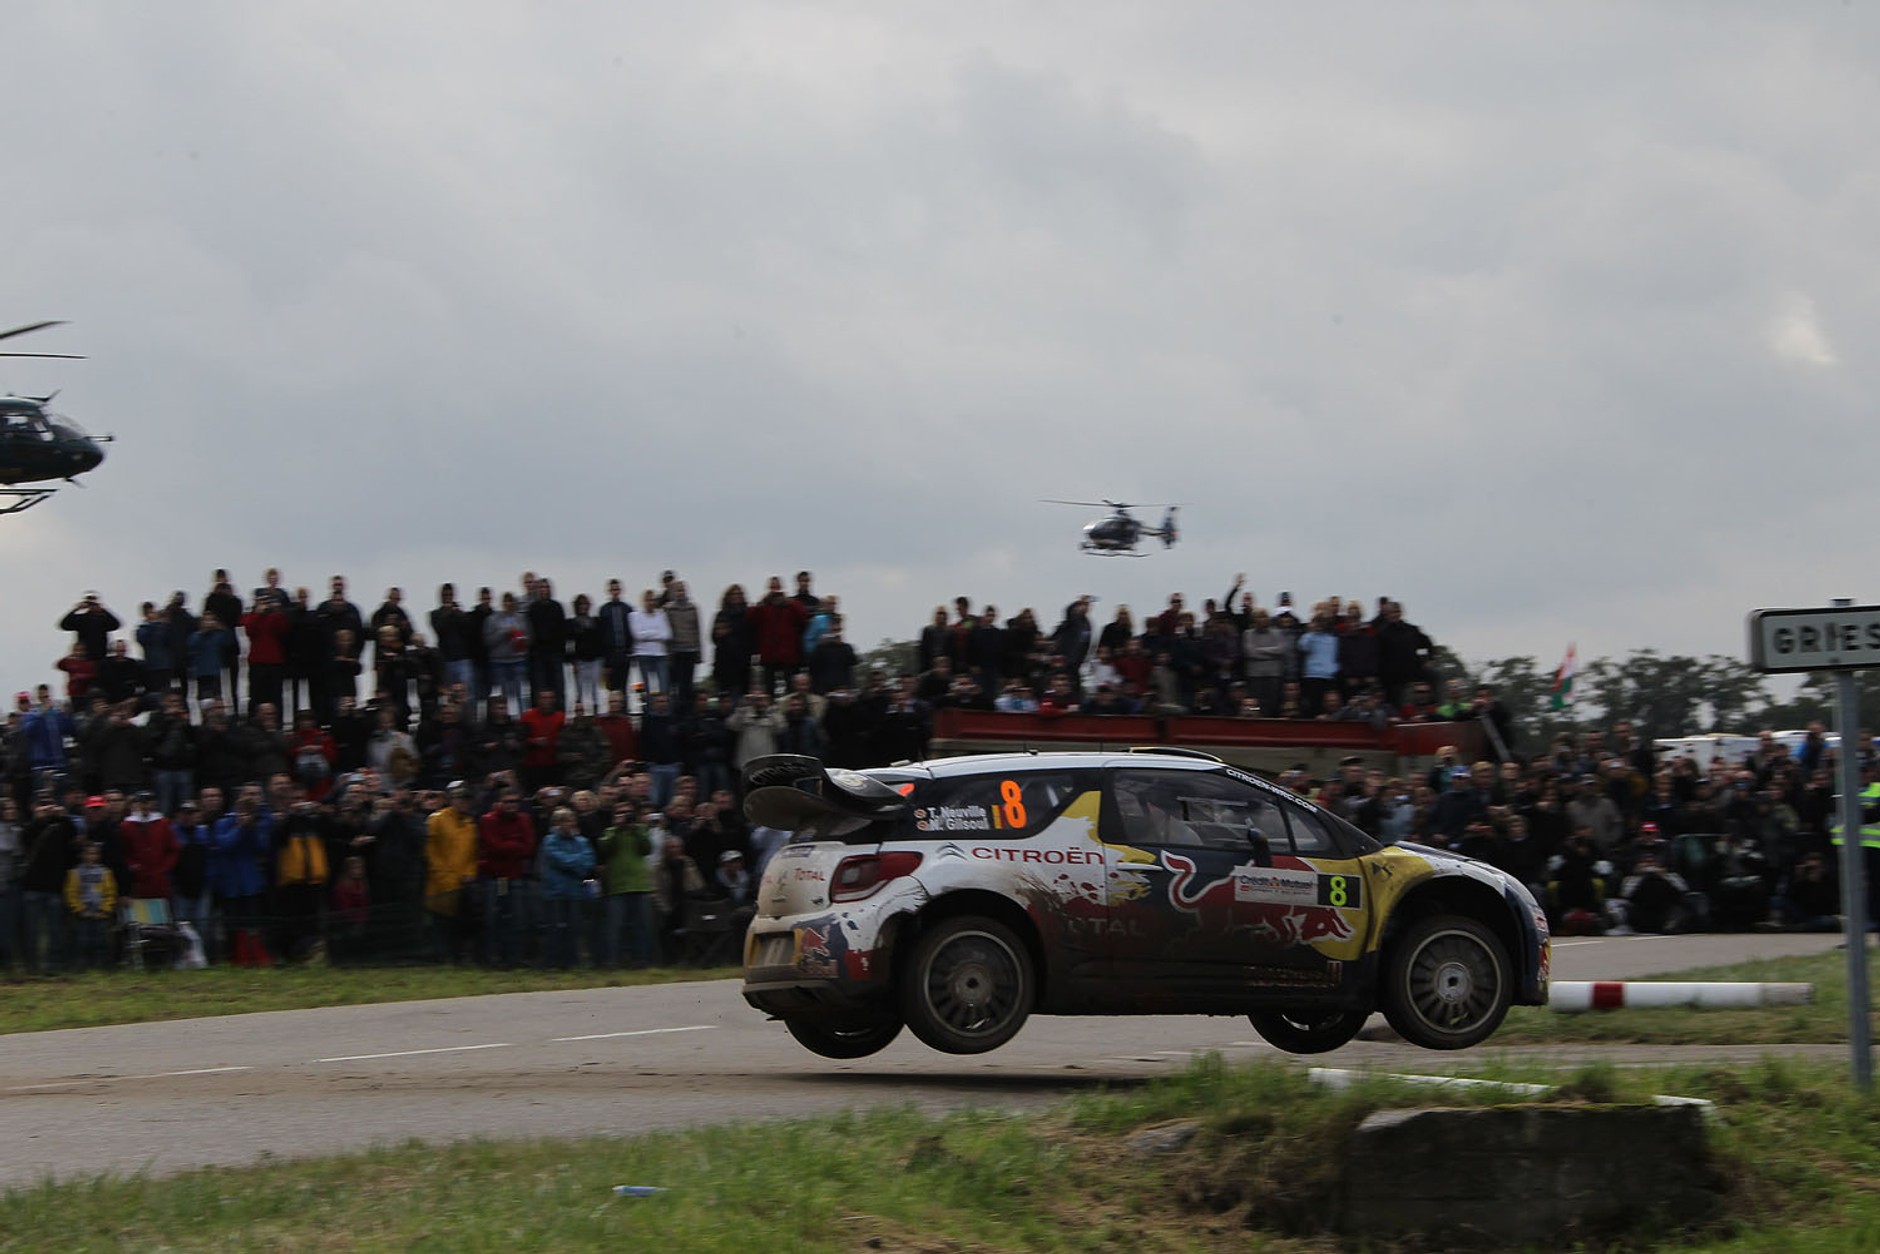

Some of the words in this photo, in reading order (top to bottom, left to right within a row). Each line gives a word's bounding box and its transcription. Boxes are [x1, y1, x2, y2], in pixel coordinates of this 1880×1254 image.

[1773, 621, 1880, 654] GRIES
[940, 805, 987, 818] Neuville
[1000, 780, 1027, 828] 8
[972, 847, 1105, 865] CITROËN
[1330, 875, 1347, 906] 8
